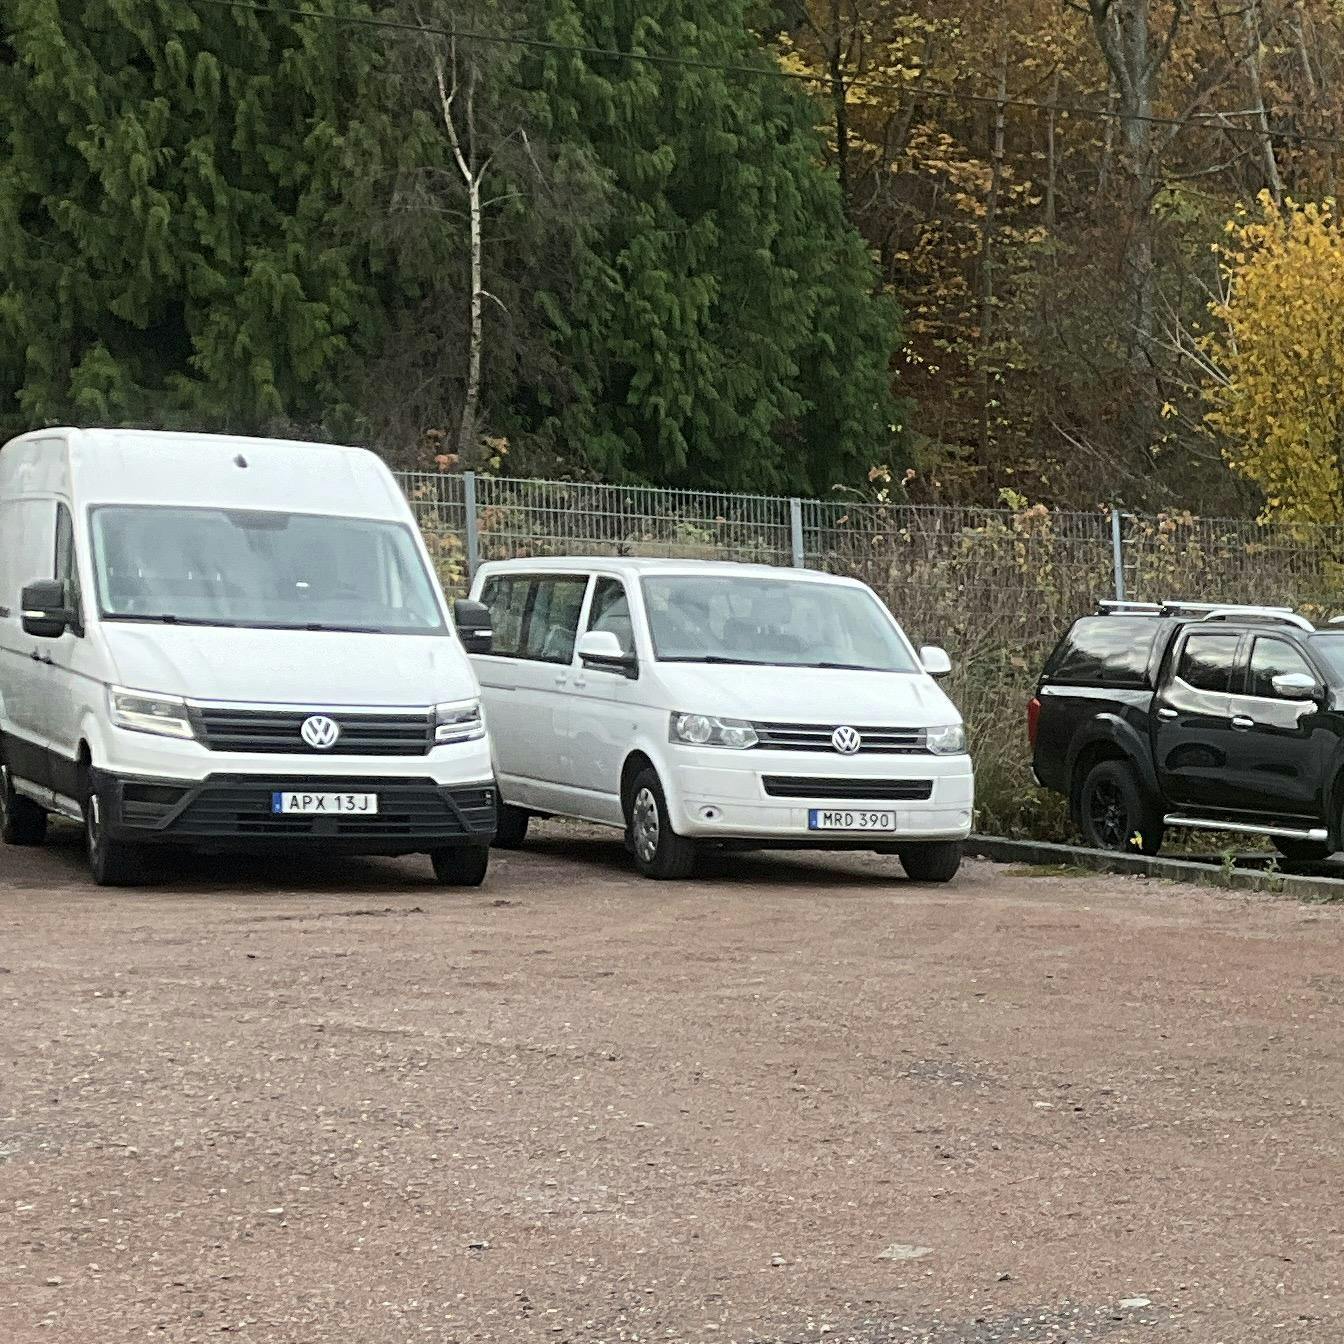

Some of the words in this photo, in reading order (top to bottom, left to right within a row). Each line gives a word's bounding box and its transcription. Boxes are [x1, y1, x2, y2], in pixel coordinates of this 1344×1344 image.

[289, 795, 326, 811] APX
[334, 795, 368, 811] 13J
[823, 811, 854, 828] MRD
[859, 813, 889, 828] 390
